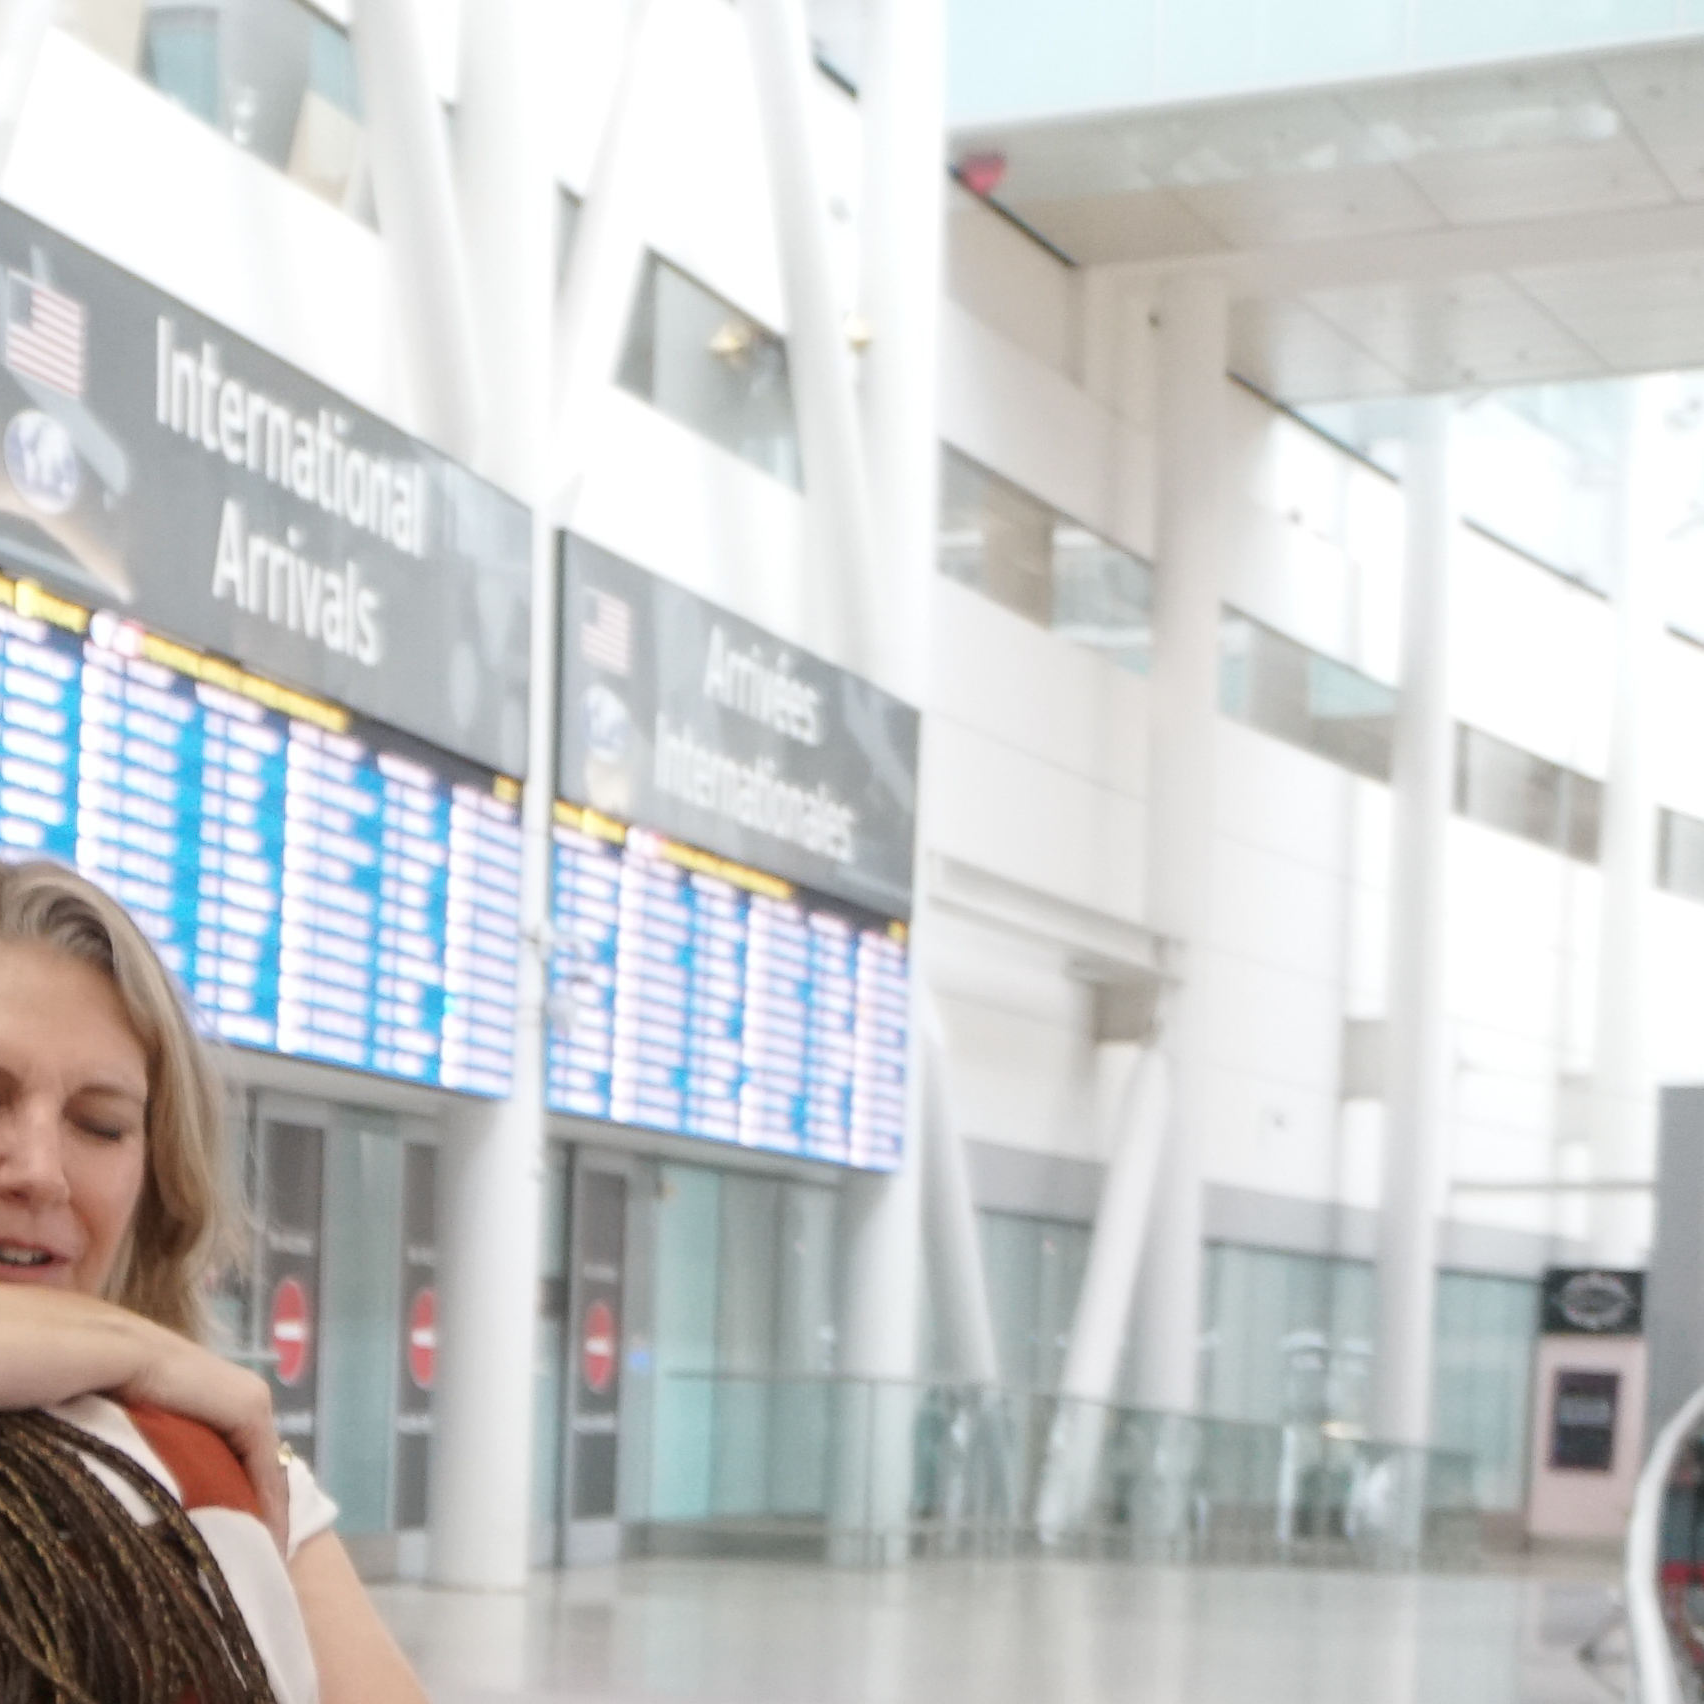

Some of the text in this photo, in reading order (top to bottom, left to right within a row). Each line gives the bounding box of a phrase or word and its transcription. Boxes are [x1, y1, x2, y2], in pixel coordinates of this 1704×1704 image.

[155, 313, 428, 560] International
[211, 498, 384, 668] Arrivals
[702, 623, 819, 747] Arrivées
